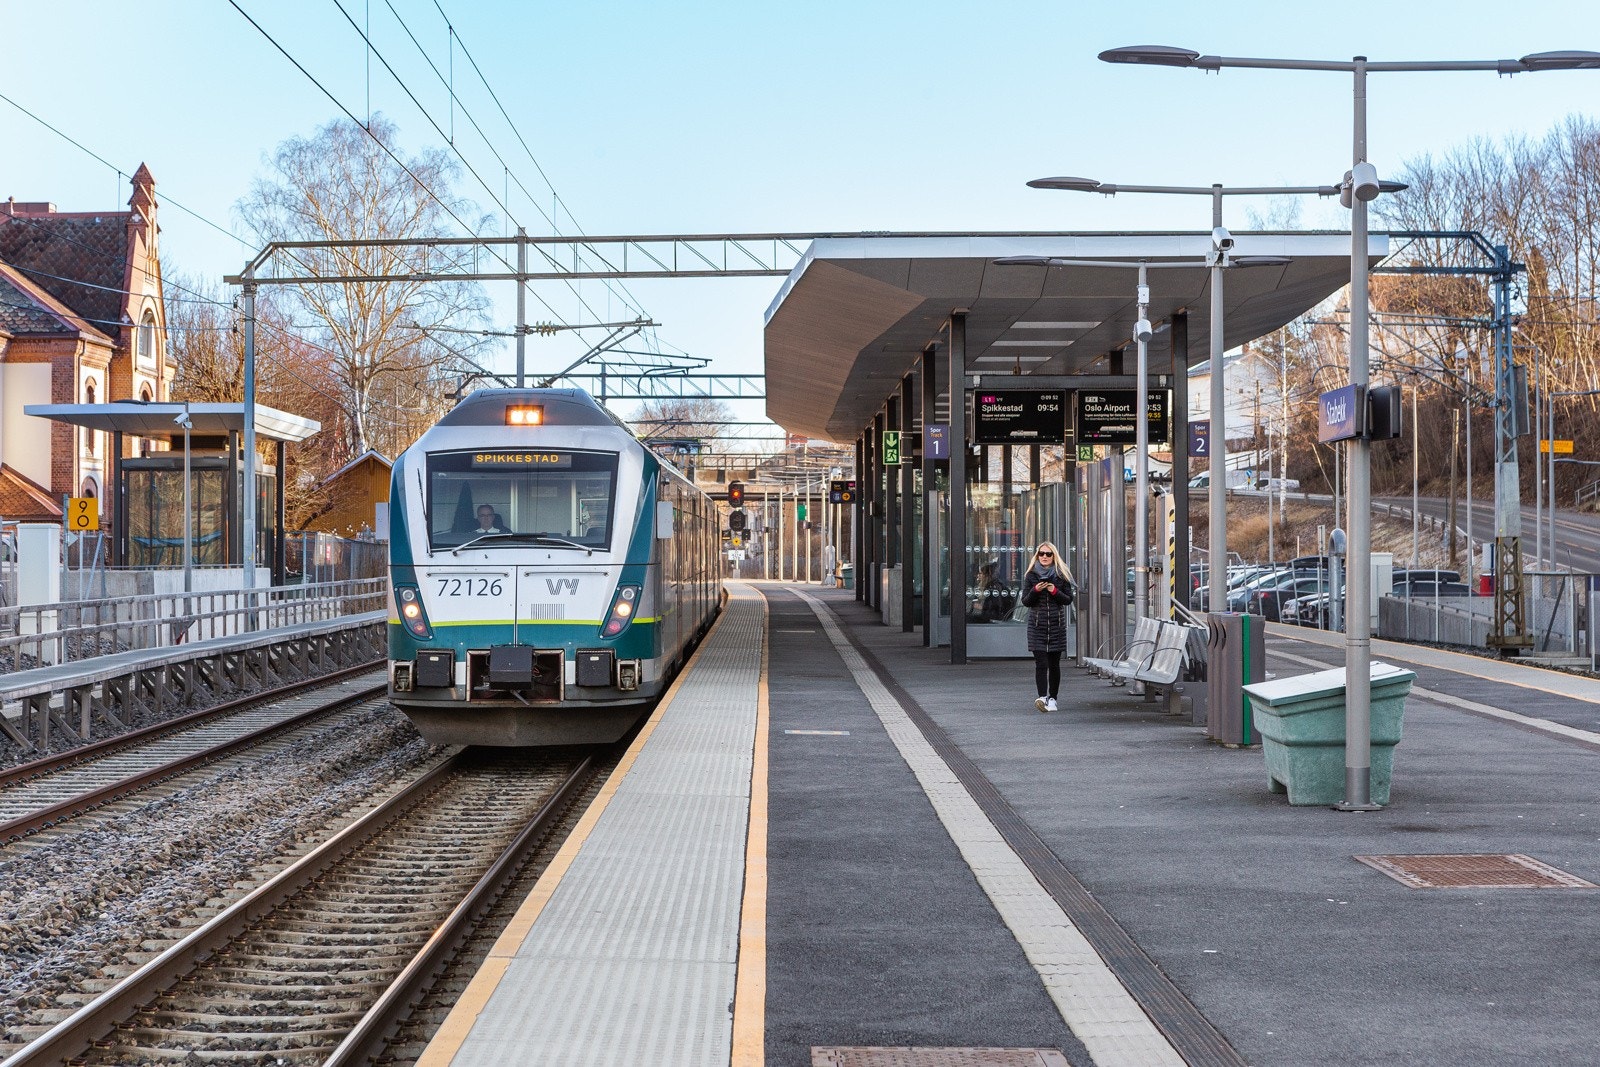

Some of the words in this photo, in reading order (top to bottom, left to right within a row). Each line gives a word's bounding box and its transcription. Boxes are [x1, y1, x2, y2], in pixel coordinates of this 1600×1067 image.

[981, 404, 1023, 413] Spikkestad
[1037, 404, 1059, 412] 09:54
[1084, 404, 1102, 412] Oslo
[1103, 404, 1130, 413] Airport
[1326, 395, 1347, 426] Stabekk
[933, 440, 939, 455] 1
[1195, 437, 1206, 452] 2
[475, 454, 560, 464] SPIKKESTAD
[437, 578, 503, 597] 72126
